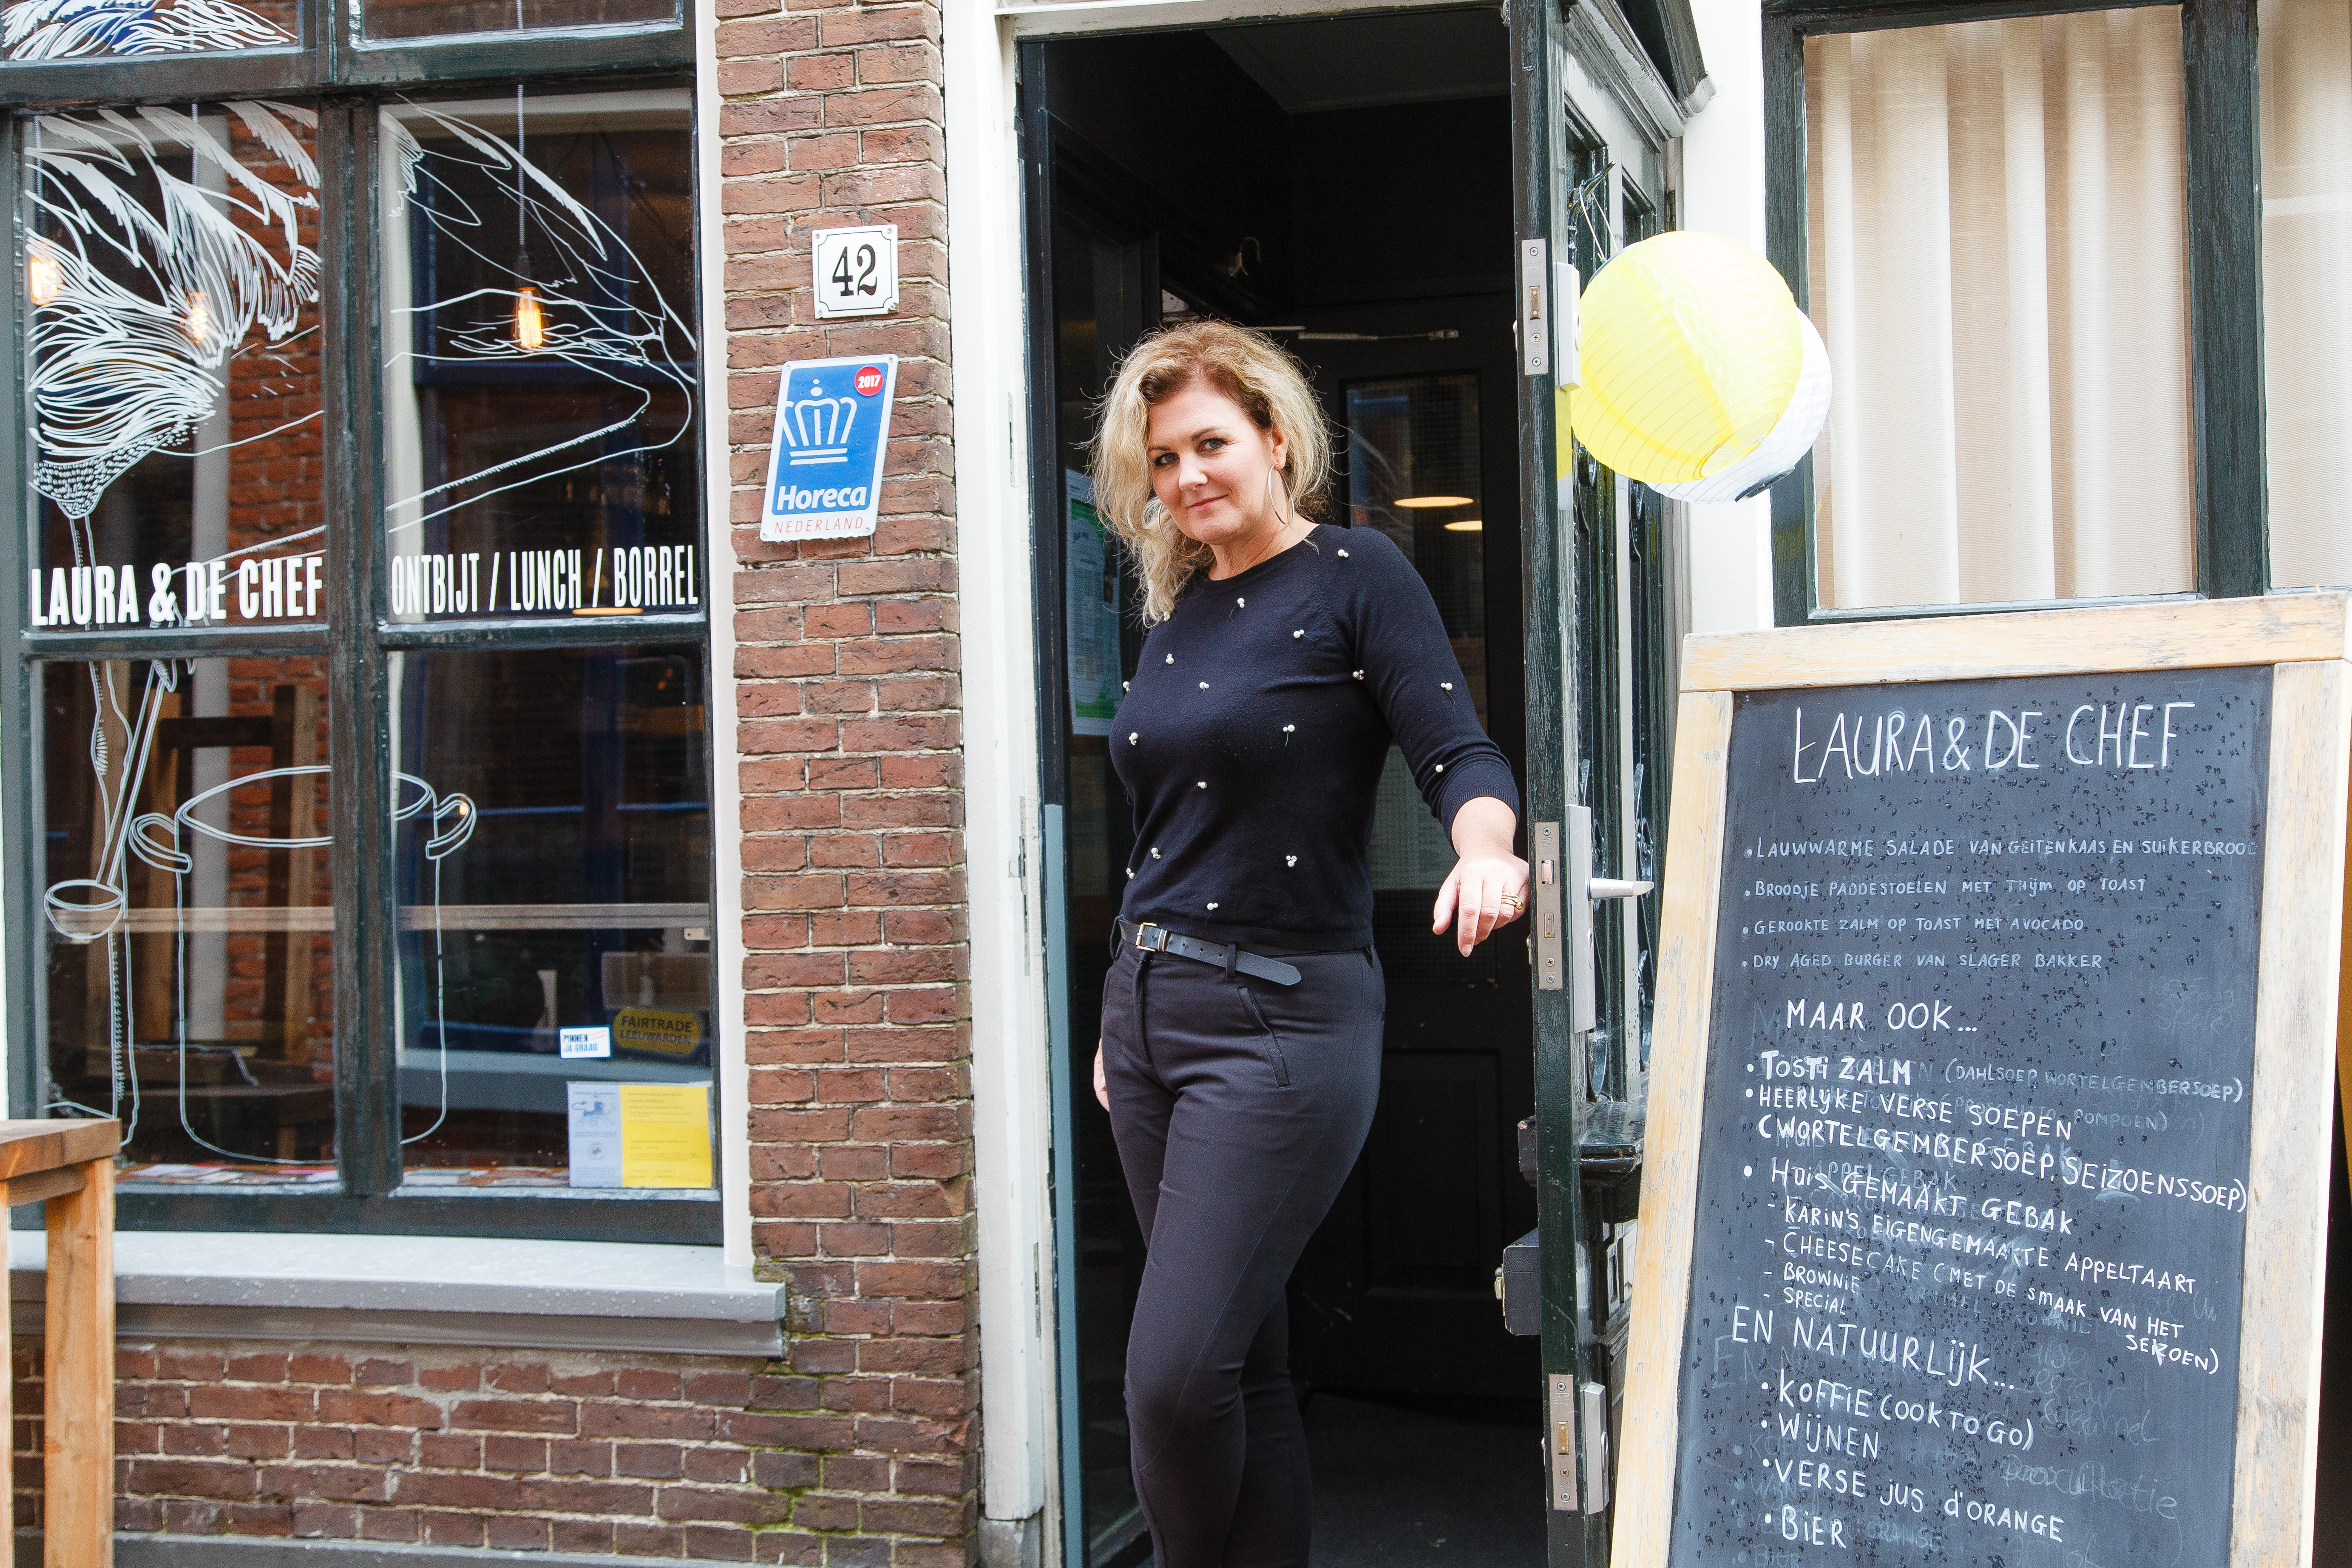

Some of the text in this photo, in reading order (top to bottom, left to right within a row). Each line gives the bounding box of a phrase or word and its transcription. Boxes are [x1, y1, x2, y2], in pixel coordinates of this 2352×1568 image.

[832, 244, 877, 296] 42
[857, 374, 881, 389] 2017
[776, 485, 868, 510] Horeca
[775, 517, 863, 533] NEDERLAND
[31, 557, 323, 627] LAURA & DE CHEF
[392, 553, 480, 615] ONTBIJT
[510, 549, 581, 611] LUNCH
[614, 545, 698, 608] BORREL
[1794, 702, 2196, 783] LAURA & DE CHEF
[1757, 836, 1874, 858] LAUWWARME
[1886, 839, 1955, 856] SALADE
[1969, 840, 2001, 856] VAN
[2113, 839, 2133, 854] EN
[1829, 880, 1947, 896] PADDESTOELEN
[1962, 881, 1993, 893] MET
[2068, 879, 2085, 894] OP
[2100, 877, 2147, 892] TOAST
[1754, 917, 2084, 934] GEROOKTE ZALM OP TOAST MET AVOCADO
[1753, 953, 2102, 970] DRY AGED BURGER VAN SLAGER BAKKER
[621, 1015, 692, 1033] FAIRTRADE
[1787, 998, 1864, 1031] MAAR
[575, 1043, 597, 1052] GRAAG
[1838, 1058, 1912, 1086] ZALM
[1880, 1092, 1953, 1123] VERSE
[1968, 1105, 2072, 1140] SOEPEN
[1842, 1172, 1967, 1216] GEMAAKT
[1981, 1198, 2073, 1234] GEBAK
[1783, 1231, 1921, 1280] CHEESECAKE
[1995, 1279, 2017, 1298] DE
[2100, 1306, 2137, 1330] VAN
[2148, 1316, 2185, 1338] HET
[2064, 1252, 2196, 1294] APPELTAART
[1732, 1305, 1774, 1344] EN
[1774, 1458, 1867, 1498] VERSE
[1943, 1491, 2065, 1543] d'ORANGE
